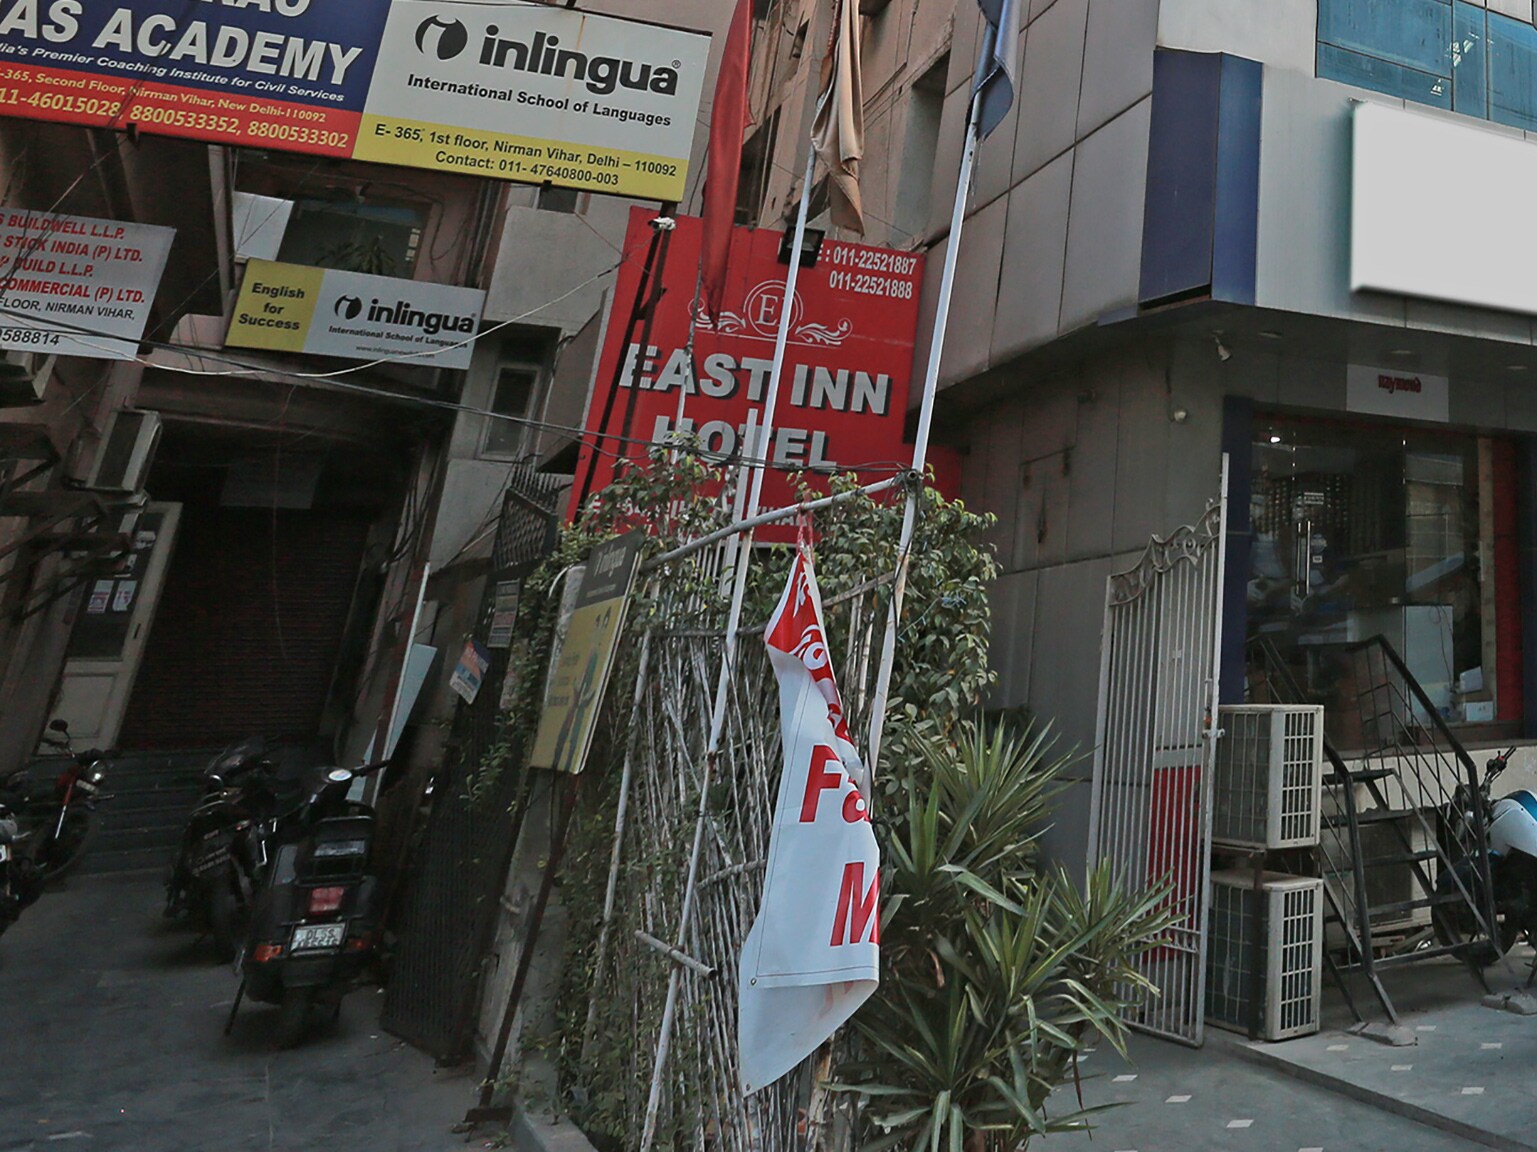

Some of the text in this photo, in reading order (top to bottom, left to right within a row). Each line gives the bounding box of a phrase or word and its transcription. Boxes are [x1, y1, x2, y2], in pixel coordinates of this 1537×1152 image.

[93, 8, 363, 86] ACADEMY
[479, 24, 679, 96] inlingua
[32, 48, 94, 65] Premier
[97, 56, 167, 77] Coaching
[170, 68, 228, 85] Institute
[231, 77, 252, 88] for
[254, 81, 286, 93] Civil
[288, 85, 345, 102] Services
[0, 67, 326, 123] -365, Second Floor, Nirman Vihar, New Delhi-110092
[407, 73, 671, 127] International School of Languages
[247, 121, 349, 148] 8800533302
[395, 125, 424, 144] 365,
[429, 131, 450, 146] 1st
[454, 134, 489, 152] floor,
[494, 139, 542, 158] Nirman
[547, 147, 583, 165] Vihar,
[587, 151, 620, 169] Delhi
[634, 159, 677, 177] 110092
[435, 151, 619, 186] Contact: 011- 47640800-003
[8, 214, 86, 236] BUILDWELL
[91, 224, 125, 239] L.L.P.
[4, 235, 142, 262] STICK INDIA (P) LTD.
[833, 247, 917, 275] 011-22521887
[15, 257, 55, 273] BUILD
[58, 262, 93, 277] L.L.P.
[0, 277, 144, 303] COMMERCIAL (P) LTD.
[252, 282, 305, 299] English
[829, 270, 913, 300] 011-22521888
[45, 302, 94, 315] NIRMAN
[97, 306, 135, 320] VIHAR,
[238, 313, 300, 330] Success
[263, 302, 284, 315] for
[367, 298, 475, 334] inlingua
[0, 328, 60, 346] 588814
[329, 325, 383, 338] International
[385, 332, 413, 342] School
[415, 335, 423, 343] of
[619, 343, 889, 415] EAST INN
[652, 416, 837, 470] HOEL
